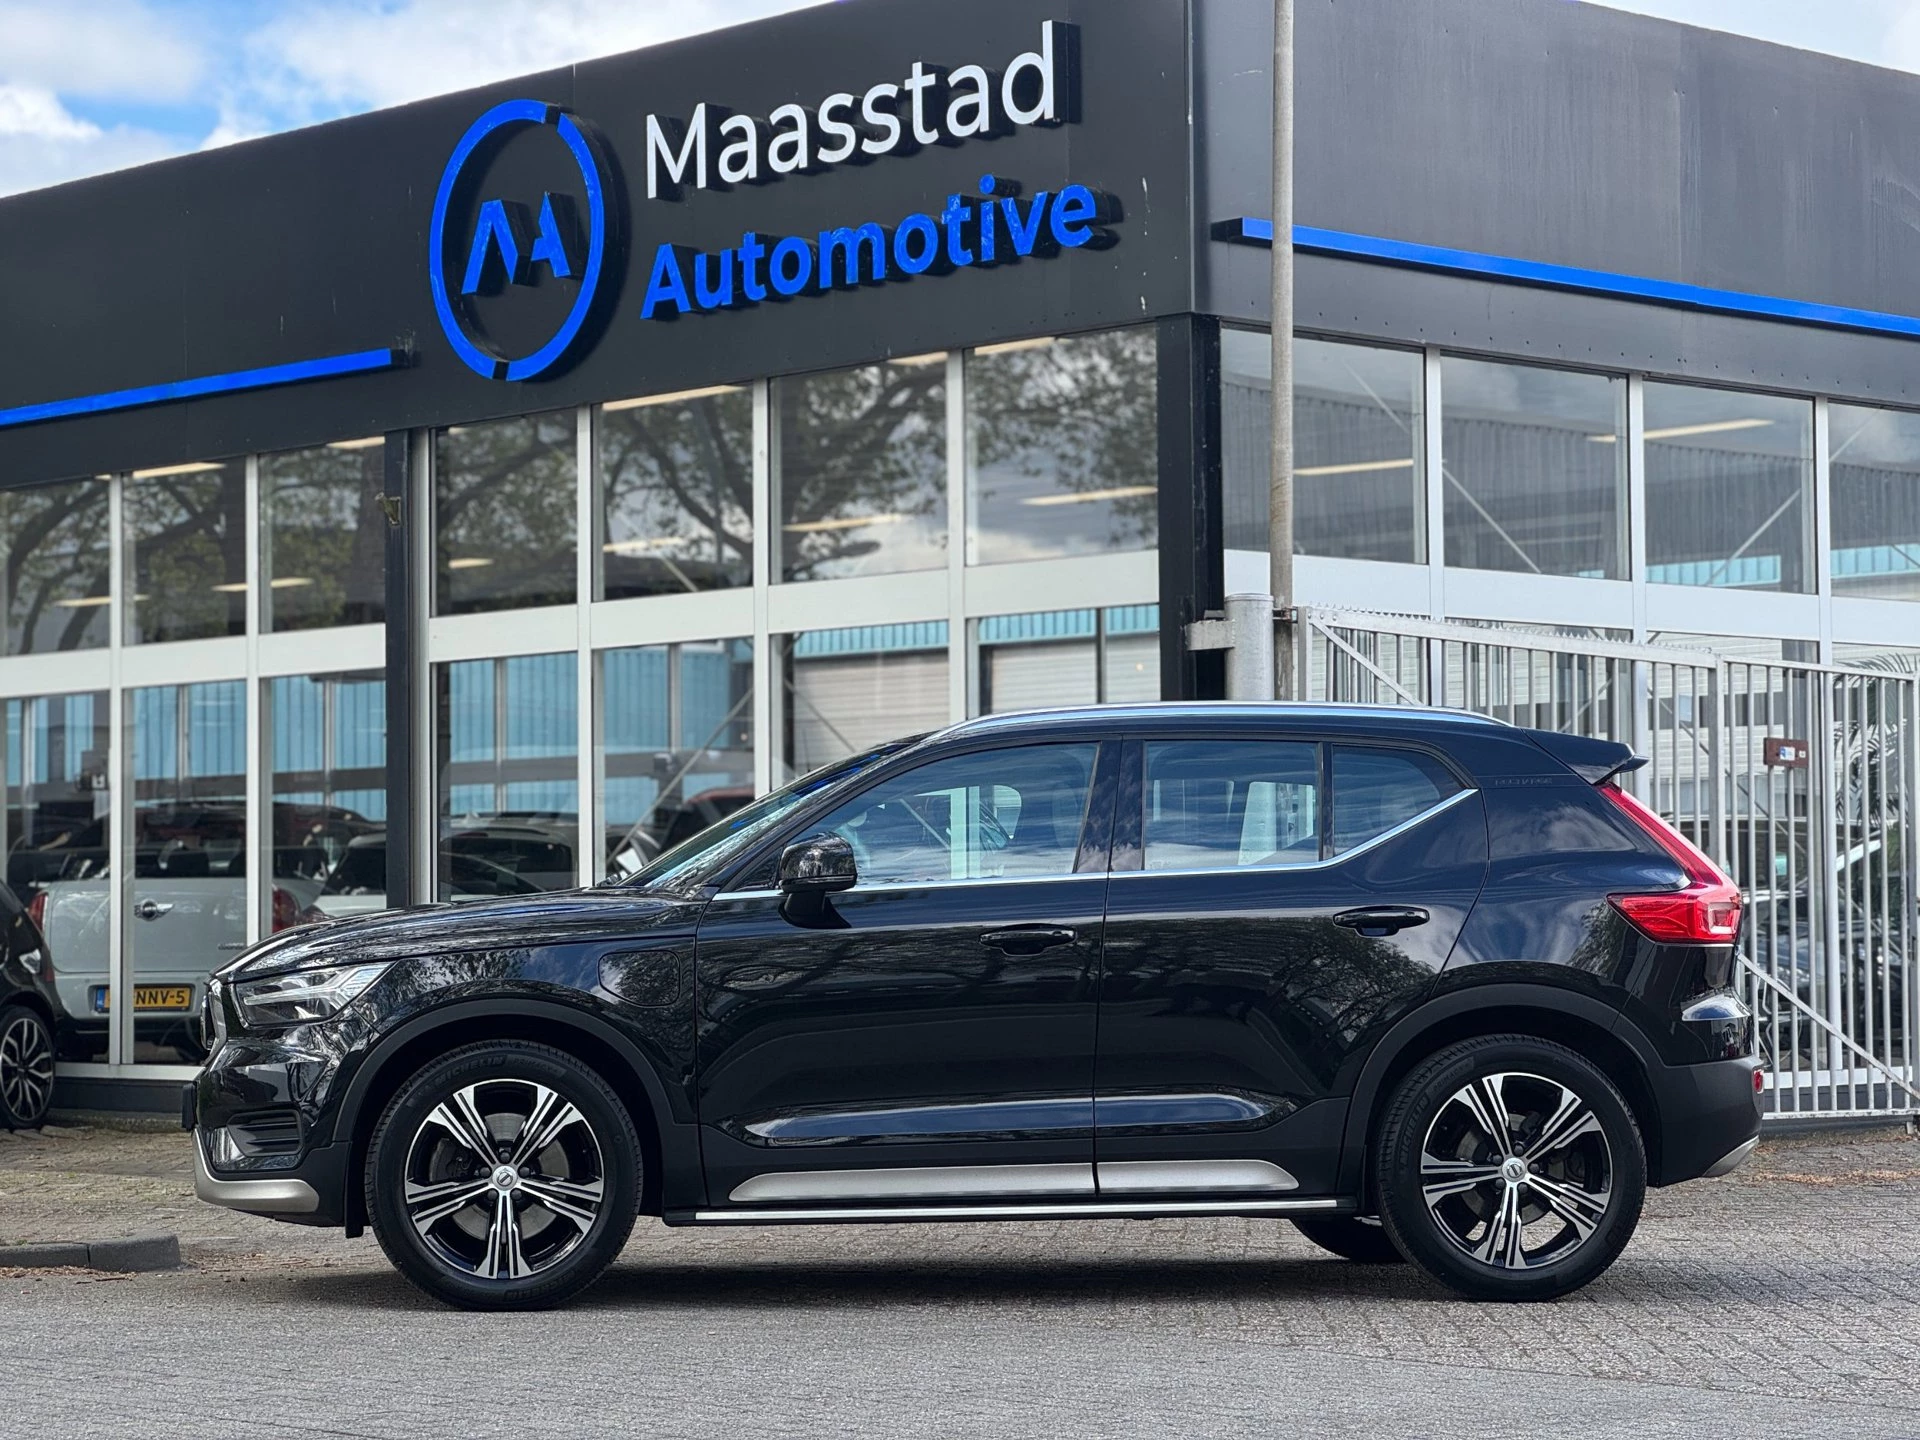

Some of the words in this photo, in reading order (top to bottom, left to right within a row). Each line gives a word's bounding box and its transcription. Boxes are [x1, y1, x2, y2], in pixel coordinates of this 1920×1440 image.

[646, 19, 1057, 200] Maasstad
[641, 174, 1096, 320] Automotive
[134, 989, 186, 1005] NNV-5
